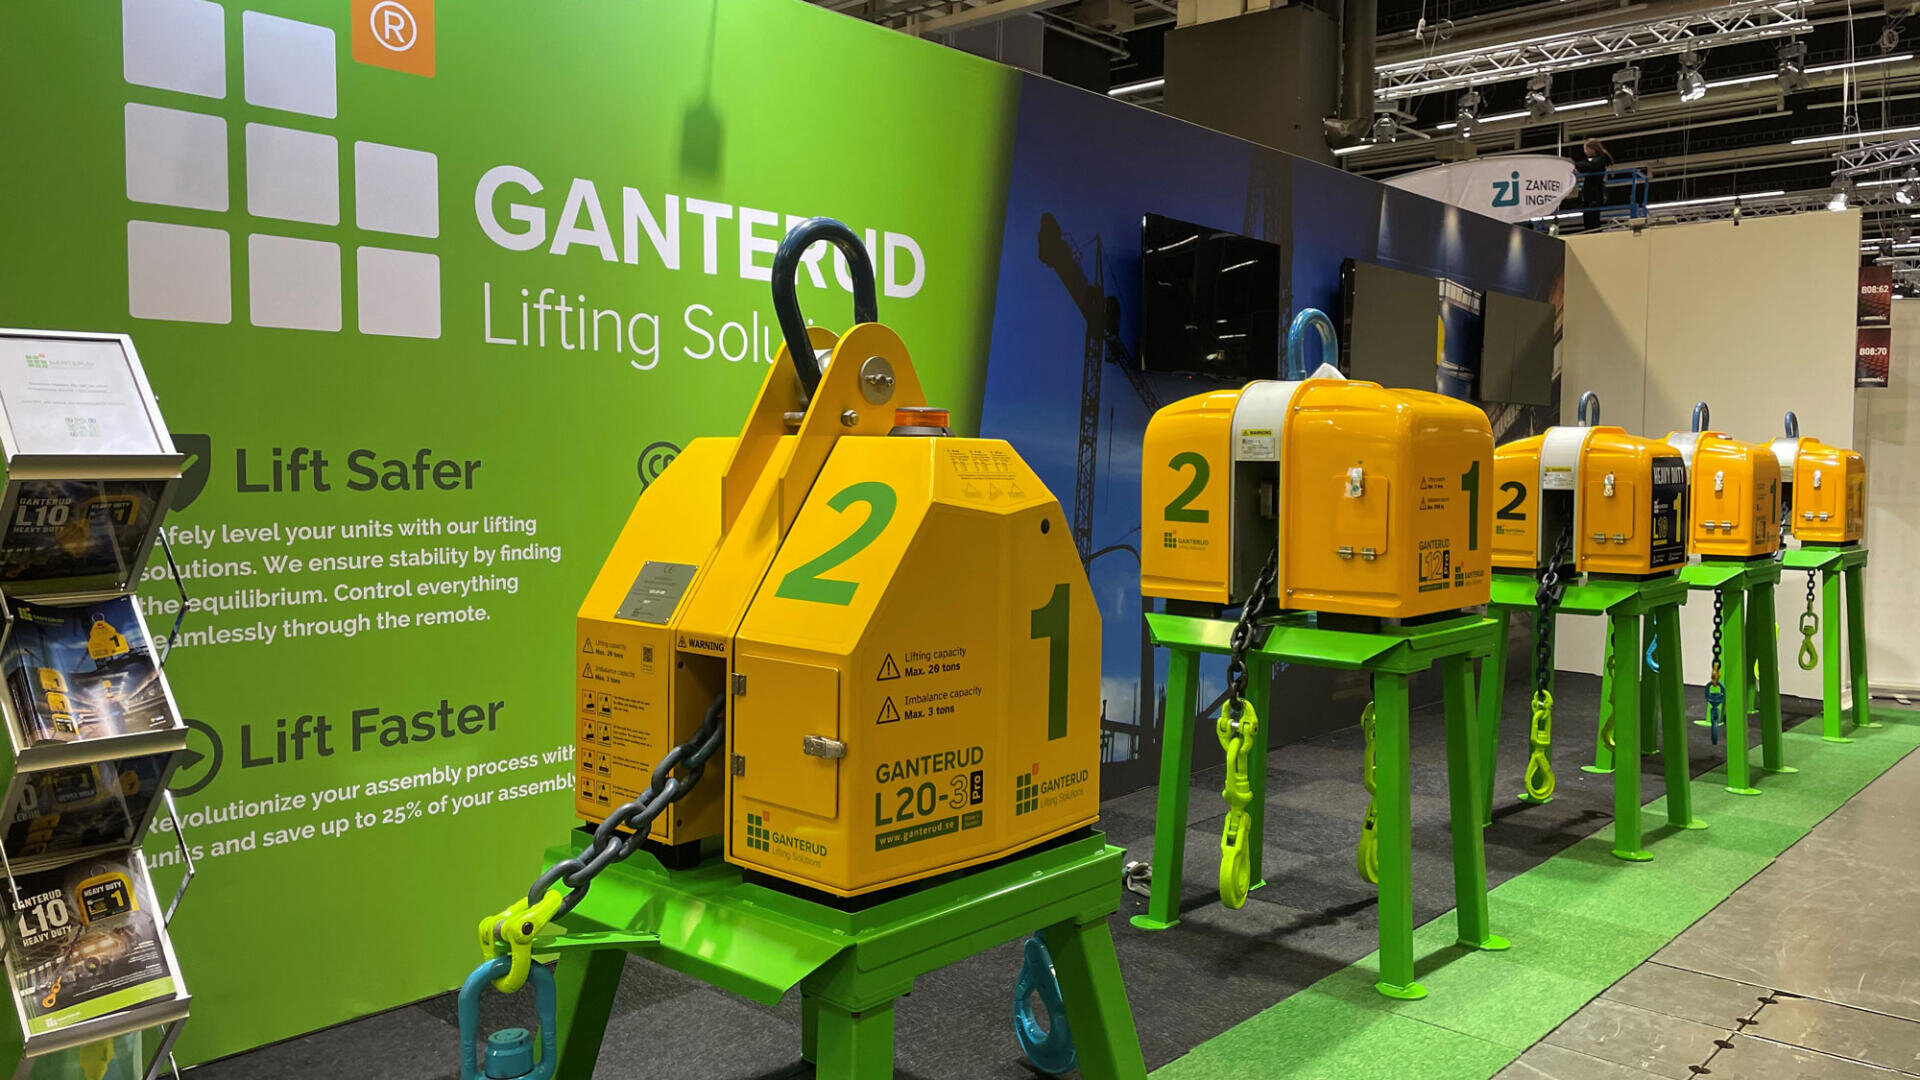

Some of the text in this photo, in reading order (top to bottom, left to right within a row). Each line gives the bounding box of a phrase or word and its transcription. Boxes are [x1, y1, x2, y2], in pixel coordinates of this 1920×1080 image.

[1861, 285, 1889, 294] B08:62
[484, 282, 660, 371] Lifting
[1859, 347, 1887, 356] B08:70
[236, 447, 482, 493] Lift Safer
[1164, 451, 1210, 523] 2
[1653, 466, 1684, 484] HEAVY DUTY
[15, 505, 70, 526] L10
[1461, 460, 1479, 551] 1
[1496, 481, 1527, 520] 2
[1673, 492, 1681, 542] 1
[1770, 478, 1777, 524] 1
[154, 515, 537, 550] fely level your units with our lifting
[774, 481, 898, 606] 2
[1419, 538, 1450, 551] GANTERUD
[140, 543, 562, 582] solutions. We ensure stability by finding
[1418, 550, 1442, 583] L12
[141, 574, 519, 616] the equilibrium. Control everything
[152, 605, 491, 650] eamlessly through the remote.
[688, 638, 725, 652] WARNING
[904, 647, 966, 662] Lifting capacity
[905, 662, 960, 677] Max. 20 tons
[1030, 583, 1071, 741] 1
[904, 705, 954, 720] Max. 3 tons
[905, 686, 982, 705] Imbalance capacity
[241, 699, 506, 769] Lift Faster
[311, 784, 360, 811] your
[365, 764, 461, 797] assembly
[466, 753, 538, 783] process
[875, 746, 984, 783] GANTERUD
[1040, 769, 1089, 794] GANTERUD
[875, 774, 982, 827] L20-3 Pro
[144, 844, 205, 869] unis
[211, 830, 256, 857] and
[262, 823, 316, 848] save
[321, 817, 350, 838] up
[355, 811, 377, 829] to
[382, 800, 423, 825] 25%
[427, 794, 449, 815] of
[451, 790, 494, 816] your
[772, 832, 827, 857] GANTERUD
[879, 820, 955, 845] www.ganterud.se
[83, 881, 122, 897] HEAVY DUTY
[111, 890, 124, 907] 1
[18, 899, 69, 937] L10
[22, 925, 72, 947] HEAVY DUTY
